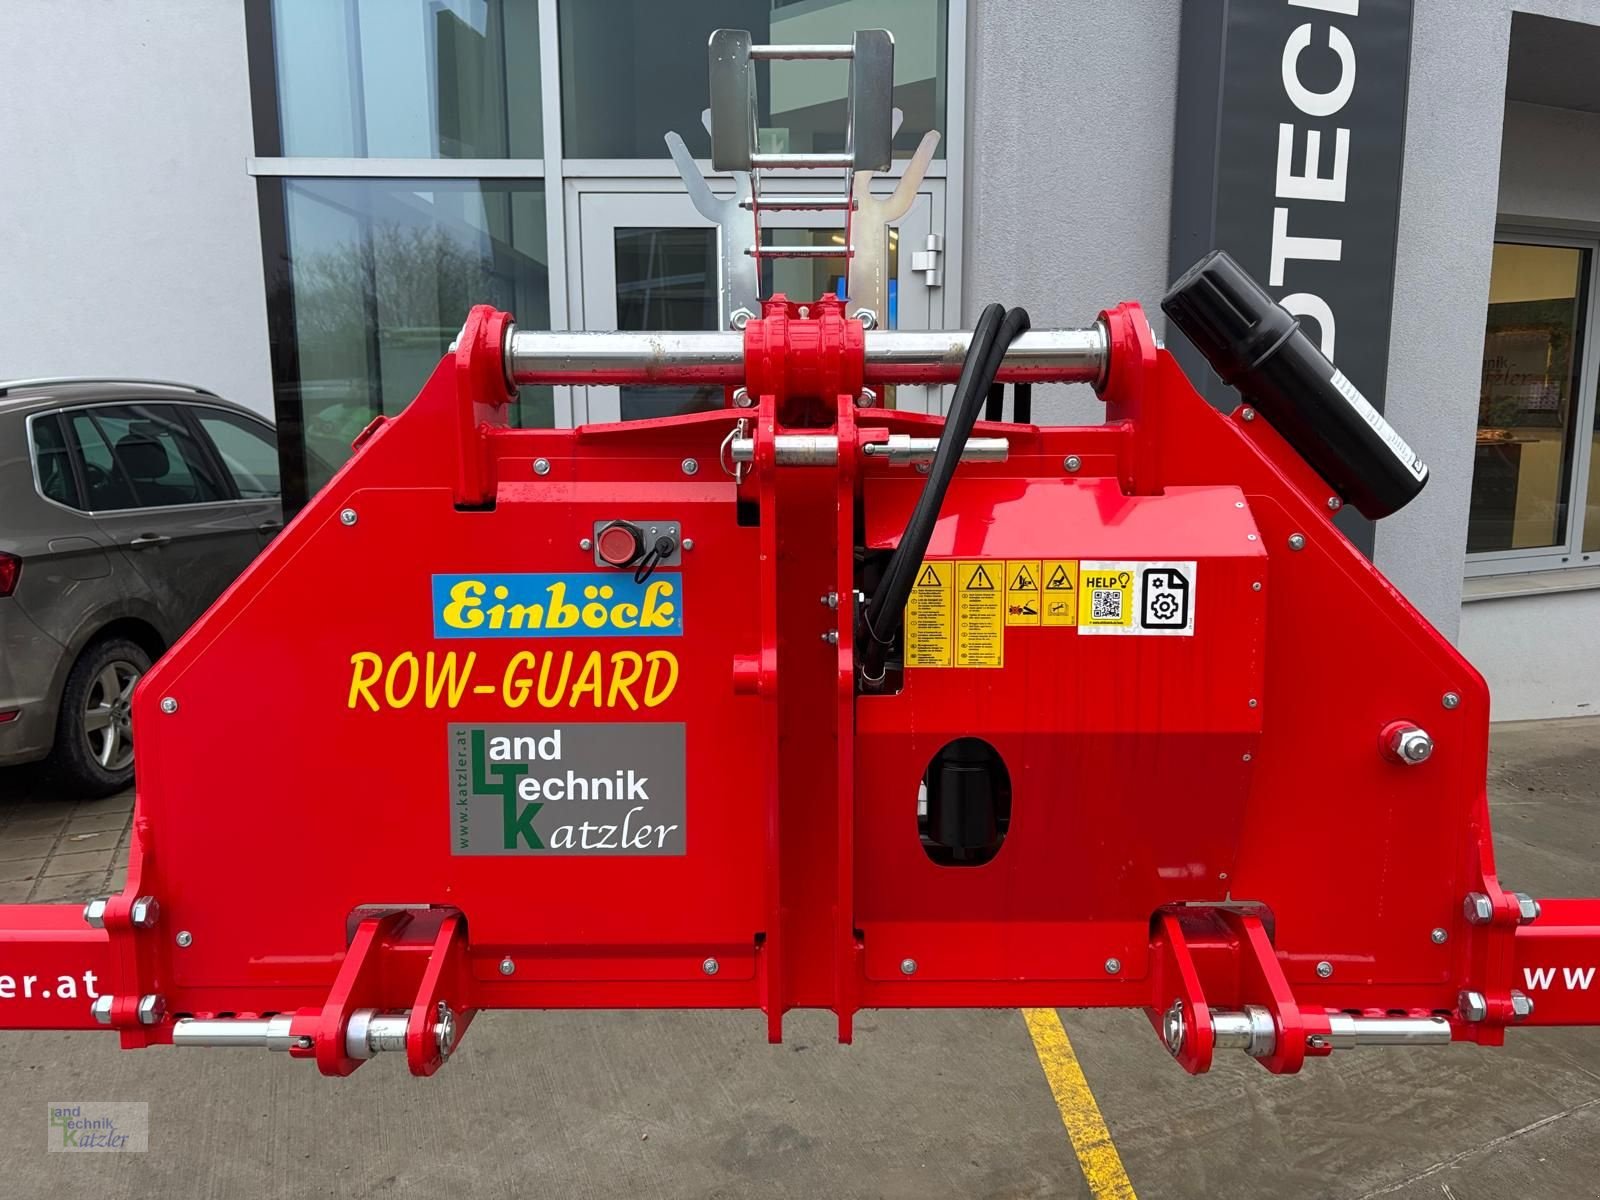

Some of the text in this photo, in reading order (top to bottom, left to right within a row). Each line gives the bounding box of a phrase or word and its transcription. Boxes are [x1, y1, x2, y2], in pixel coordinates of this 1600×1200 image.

[1270, 0, 1359, 364] TEC
[442, 580, 674, 629] Einböck
[1086, 576, 1117, 588] HELP
[346, 650, 679, 712] ROW-GUARD
[471, 728, 562, 794] Land
[490, 762, 649, 804] Technik
[456, 730, 470, 849] www.katzler.at
[503, 802, 678, 850] Katzler
[0, 970, 99, 999] er.at
[1523, 968, 1597, 990] ww
